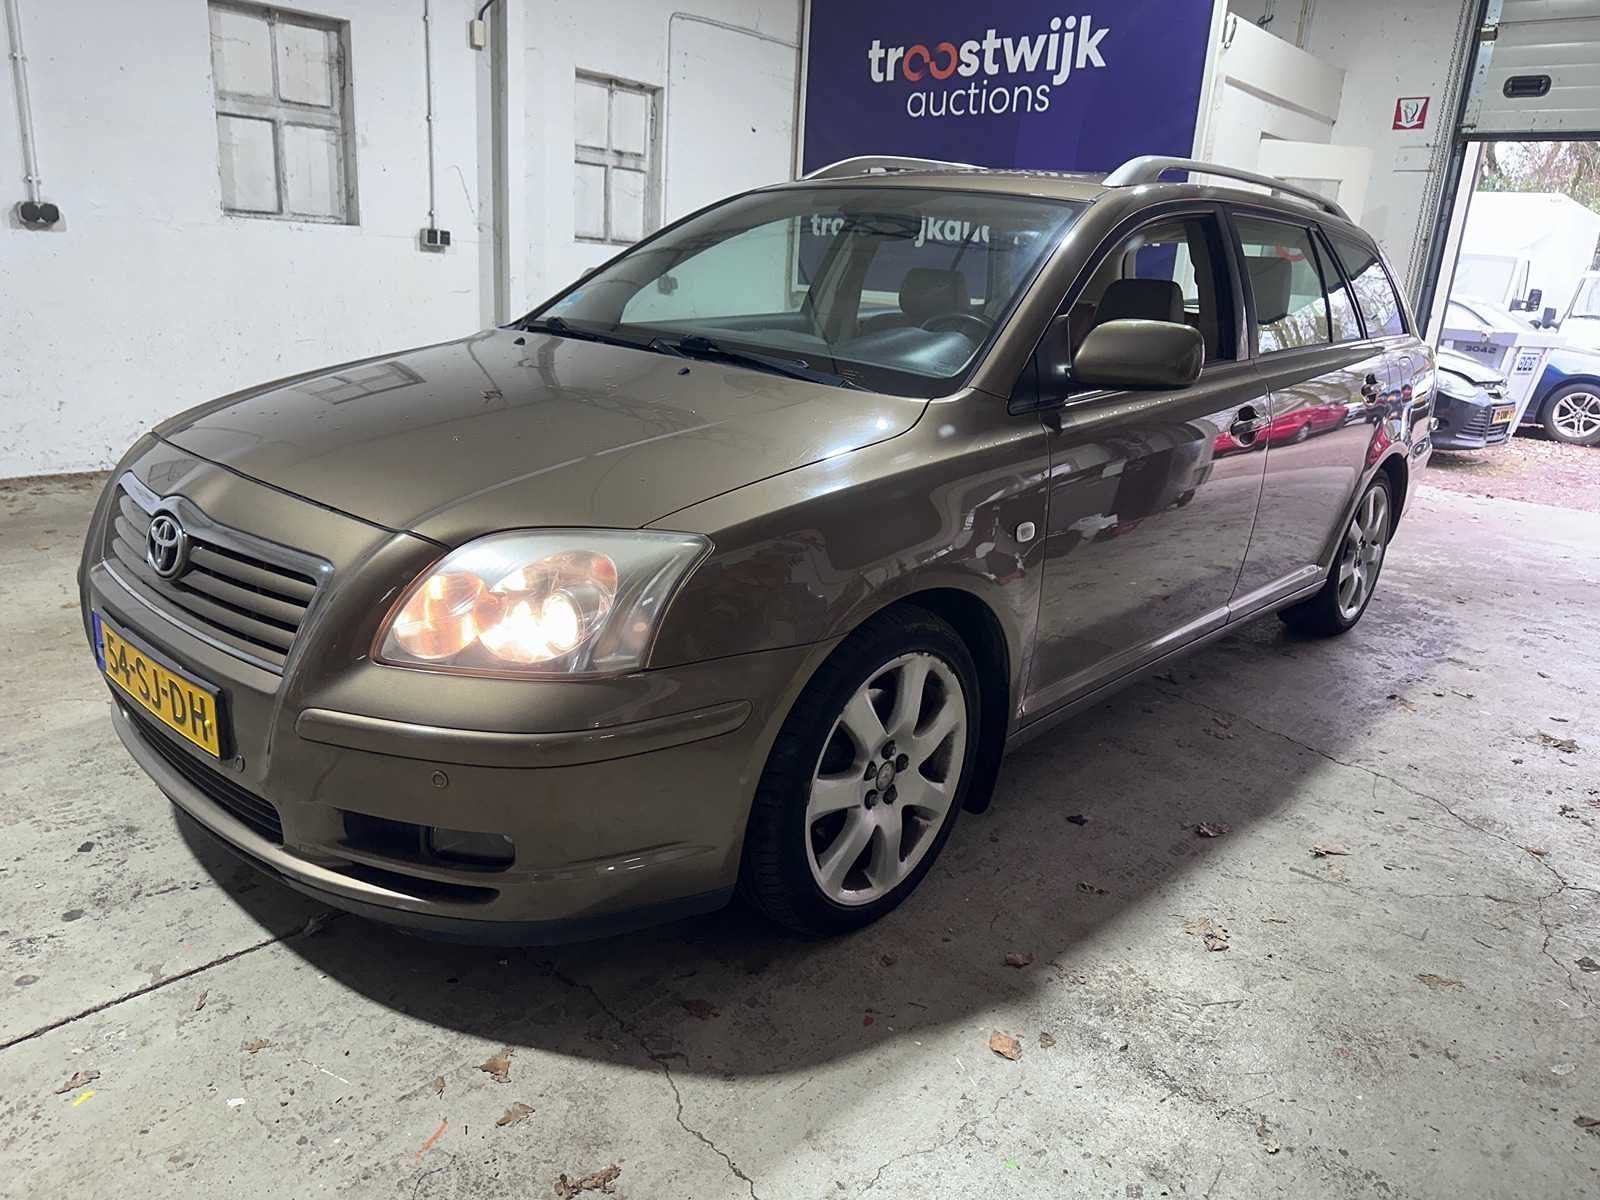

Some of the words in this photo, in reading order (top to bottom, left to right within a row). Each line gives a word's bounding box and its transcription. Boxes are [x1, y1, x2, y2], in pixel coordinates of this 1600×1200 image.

[868, 15, 1110, 86] troostwijk
[906, 79, 1050, 118] auctions
[106, 631, 210, 743] 54-SJ-DH
